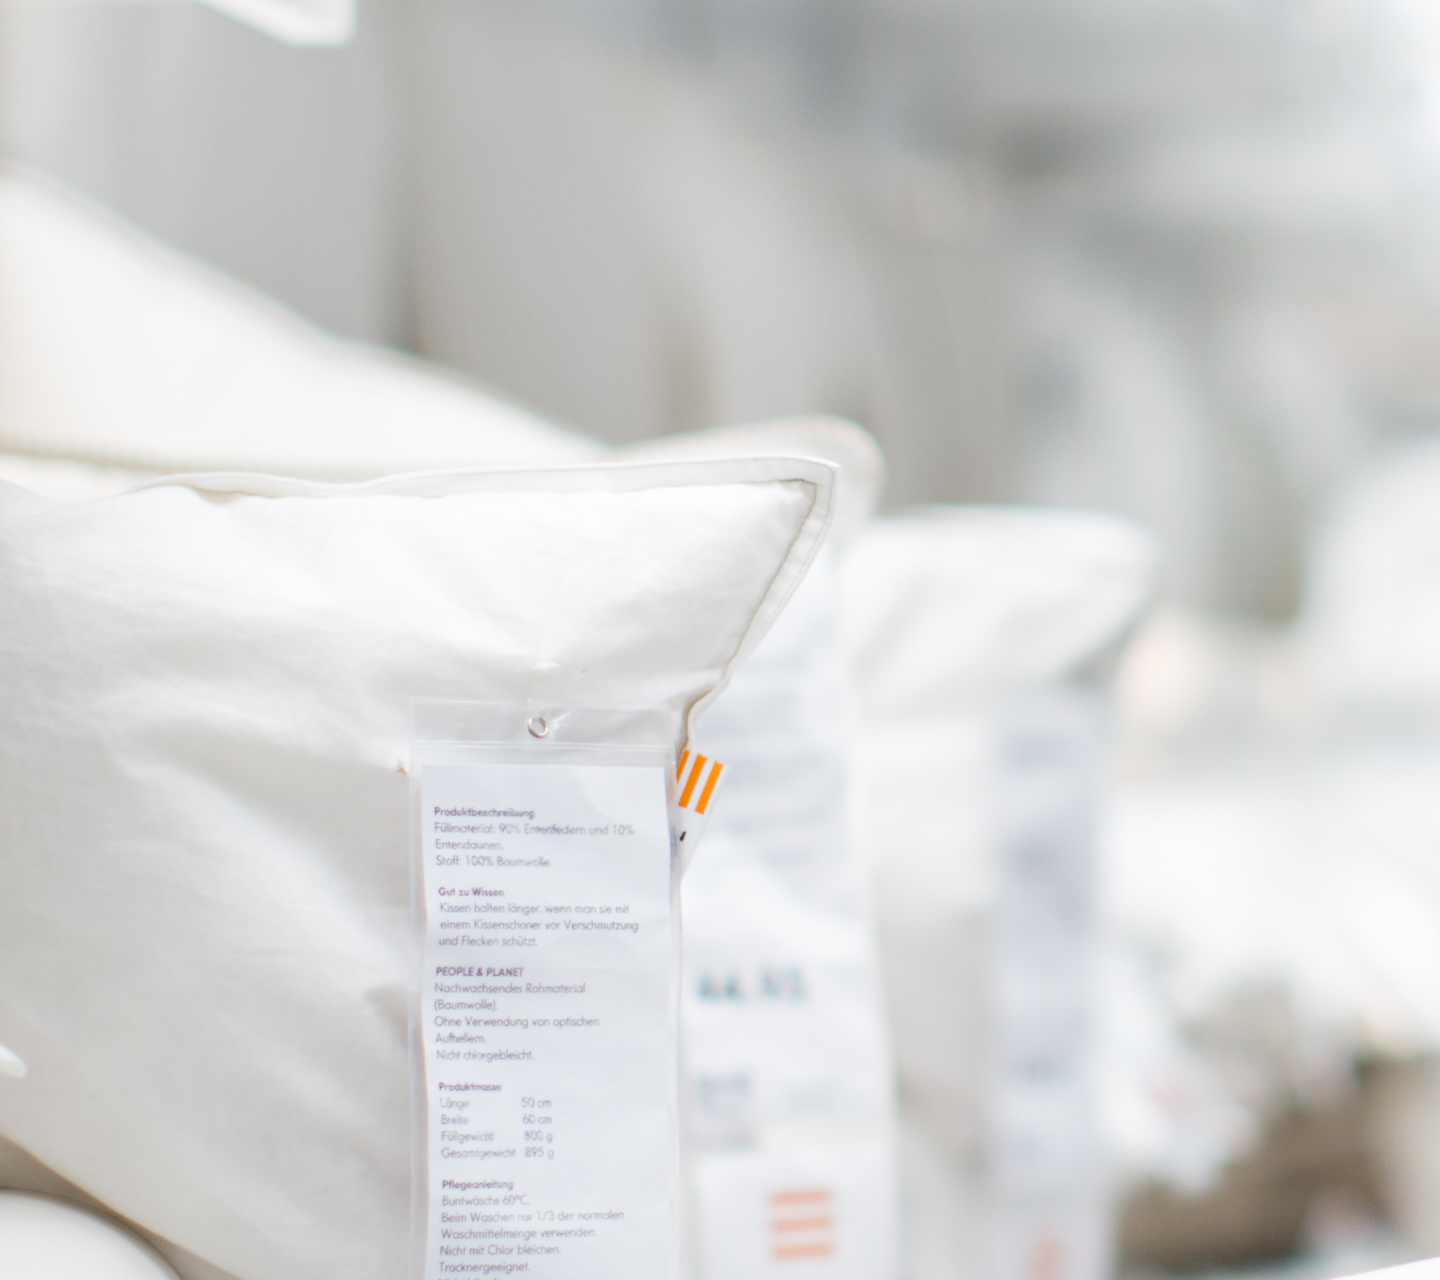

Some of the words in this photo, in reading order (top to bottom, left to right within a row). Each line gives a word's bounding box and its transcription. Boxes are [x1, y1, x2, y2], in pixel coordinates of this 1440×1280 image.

[434, 807, 535, 819] Produktbeschreibung
[434, 822, 495, 833] Füllmaterial:
[499, 823, 520, 834] 90%
[524, 824, 585, 835] Entenfedern
[589, 825, 609, 835] und
[613, 825, 635, 835] 10%
[436, 855, 462, 866] Stoff:
[466, 855, 494, 866] 100%
[497, 856, 550, 867] Baumwolle
[438, 887, 456, 896] Gut
[459, 888, 469, 896] zu
[472, 887, 504, 897] Wissen
[439, 903, 471, 913] Kissen
[474, 902, 505, 913] halten
[508, 902, 542, 915] länger,
[545, 905, 571, 913] wenn
[575, 905, 596, 913] man
[599, 904, 613, 914] sie
[615, 904, 630, 914] mit
[440, 920, 470, 929] einem
[474, 919, 541, 929] Kissenschoner
[545, 921, 560, 929] vor
[564, 920, 639, 932] Verschmutzung
[439, 936, 458, 946] und
[461, 936, 499, 946] Flecken
[502, 936, 538, 946] schützt.
[436, 967, 474, 976] PEOPLE
[476, 967, 483, 976] &
[486, 967, 524, 976] PLANET
[435, 982, 522, 993] Nachwachsendes
[525, 983, 586, 993] Rohmaterial
[434, 1000, 498, 1012] (Baumwolle).
[435, 1016, 462, 1026] Ohne
[465, 1016, 529, 1029] Verwendung
[532, 1018, 550, 1026] von
[553, 1016, 599, 1028] optischen
[437, 1050, 460, 1060] Nicht
[463, 1050, 534, 1063] chlorgebleicht.
[439, 1082, 502, 1091] Produktmasse
[440, 1098, 470, 1110] Länge
[521, 1097, 534, 1107] 50
[537, 1099, 551, 1107] cm
[441, 1115, 469, 1124] Breite
[522, 1114, 535, 1124] 60
[538, 1116, 552, 1124] cm
[442, 1131, 494, 1144] Füllgewicht
[524, 1131, 543, 1141] 800
[546, 1133, 553, 1143] g
[441, 1147, 516, 1160] Gesamtgewicht
[525, 1147, 544, 1157] 895
[547, 1150, 554, 1159] g
[442, 1180, 514, 1190] Pflegeanleitung
[442, 1196, 500, 1205] Buntwäsche
[441, 1212, 466, 1222] Beim
[470, 1212, 514, 1222] Waschen
[518, 1213, 532, 1221] nur
[536, 1210, 555, 1221] 1/3
[558, 1210, 574, 1220] der
[578, 1209, 624, 1219] normalen
[441, 1229, 537, 1240] Waschmittelmenge
[541, 1227, 597, 1237] verwenden.
[440, 1245, 466, 1255] Nicht
[470, 1245, 484, 1255] mit
[488, 1245, 514, 1254] Chlor
[517, 1245, 561, 1254] bleichen.
[439, 1262, 530, 1274] Trocknergeeignet.
